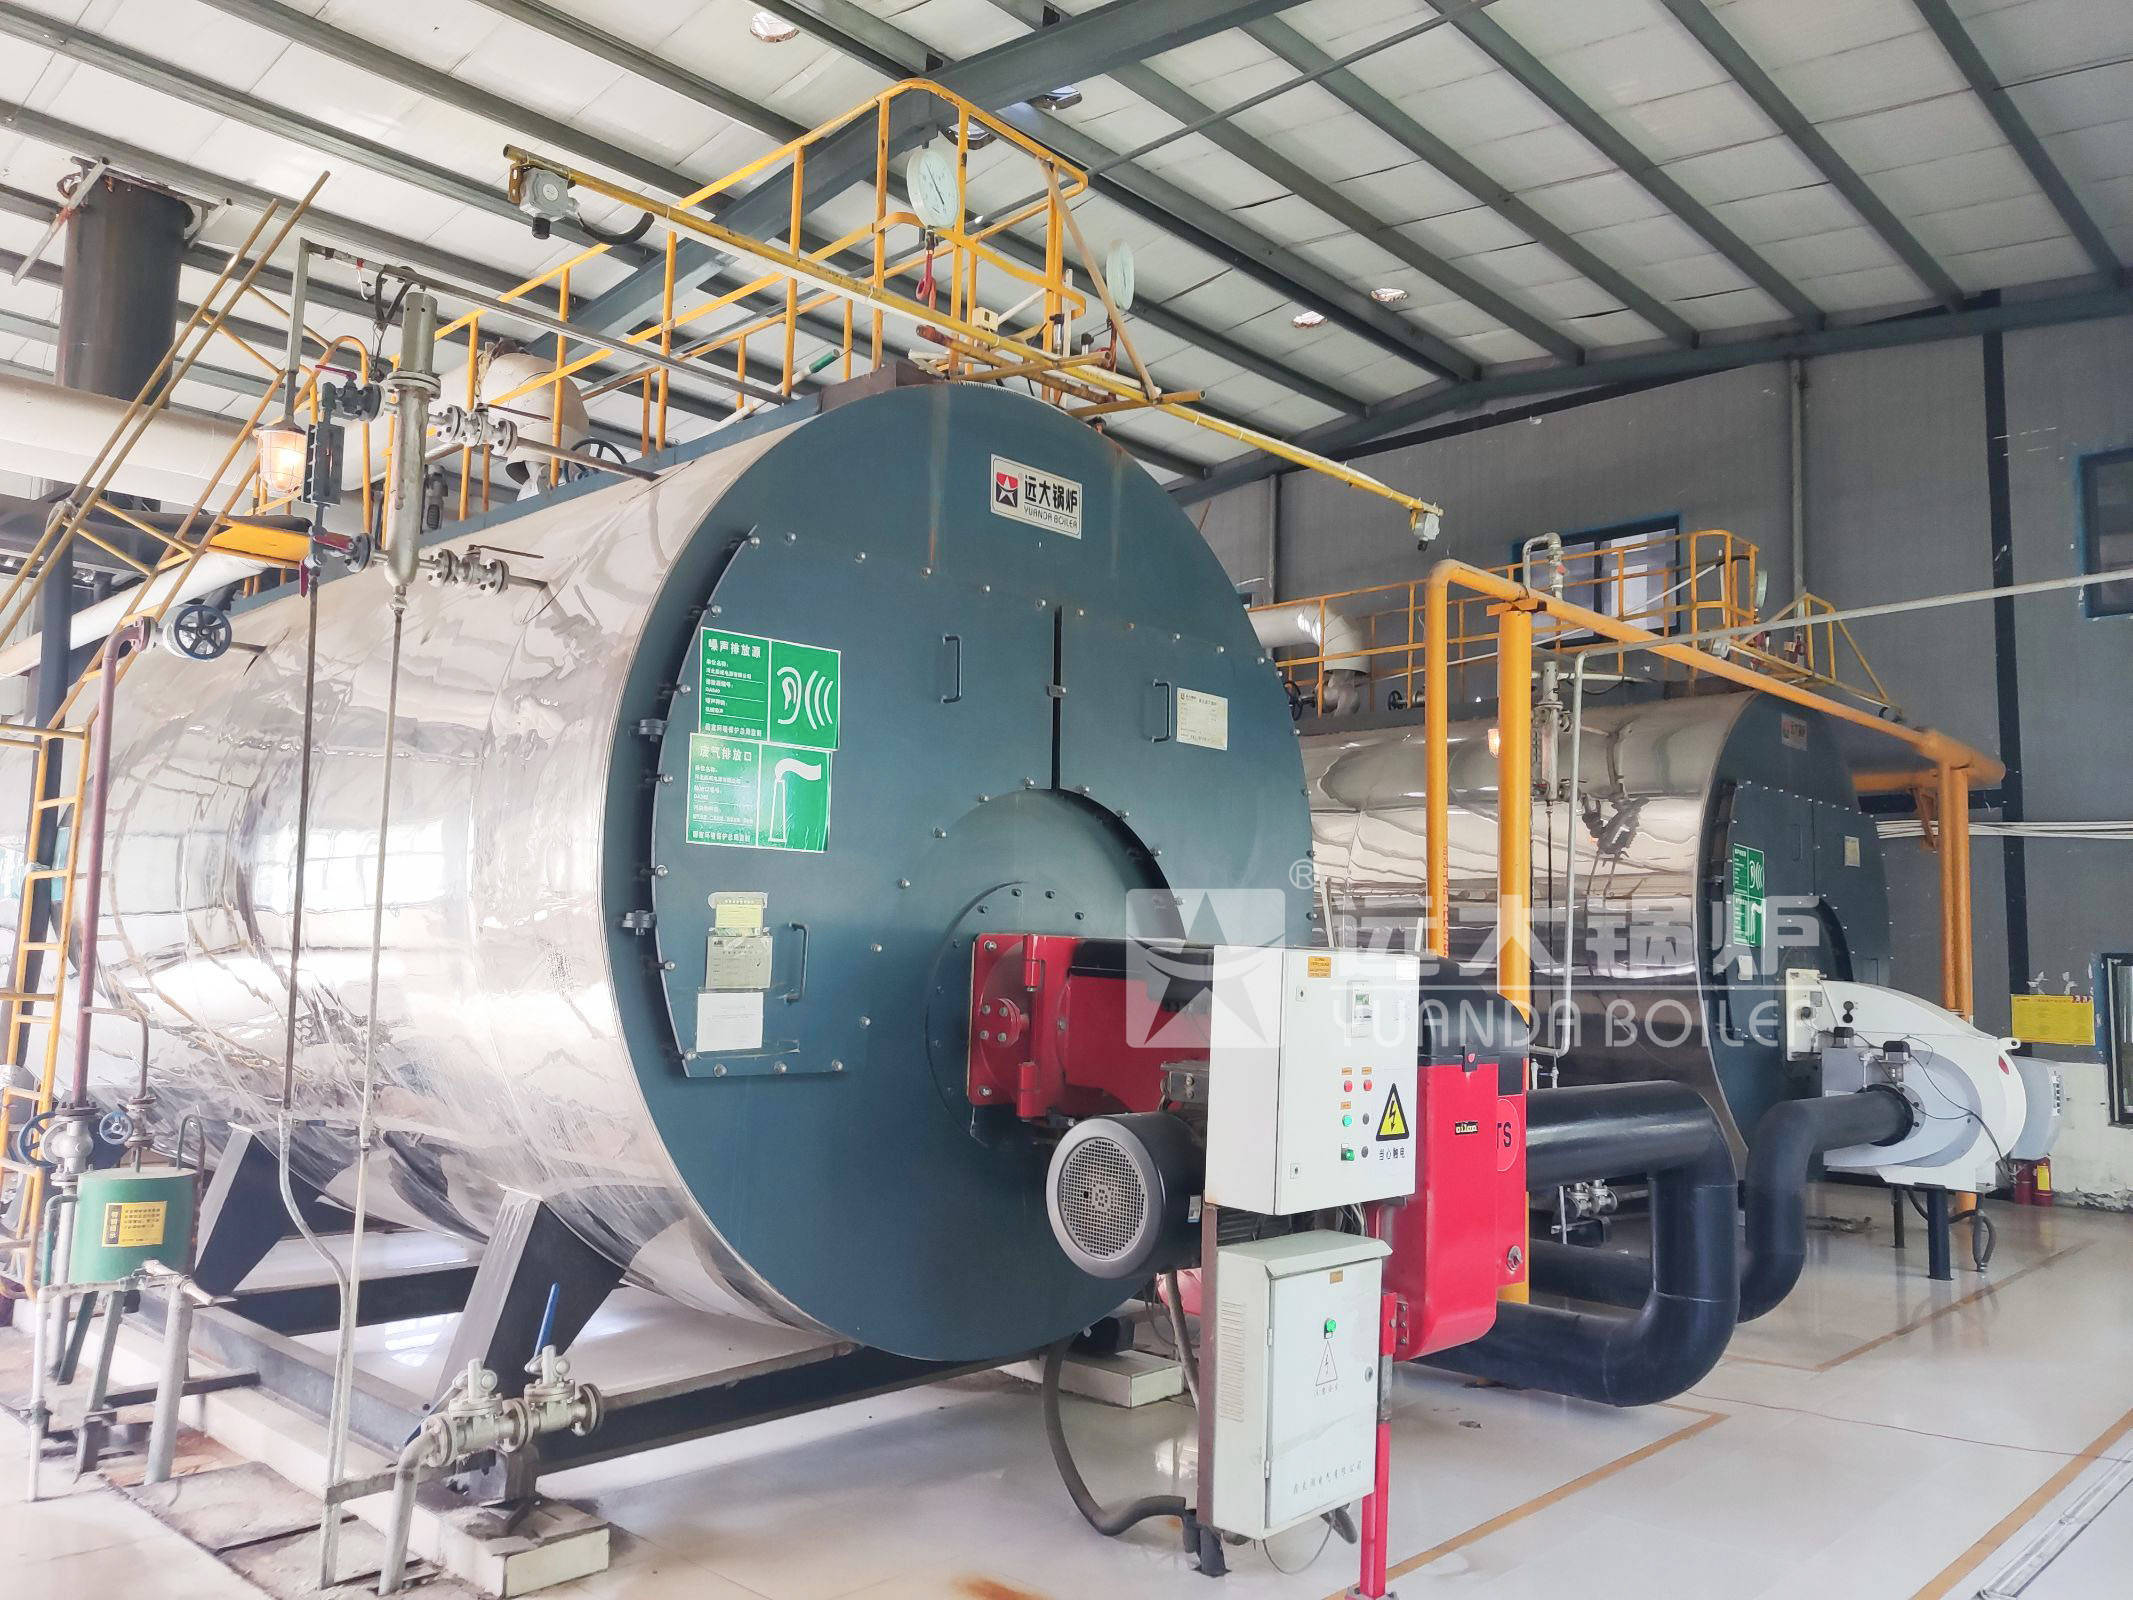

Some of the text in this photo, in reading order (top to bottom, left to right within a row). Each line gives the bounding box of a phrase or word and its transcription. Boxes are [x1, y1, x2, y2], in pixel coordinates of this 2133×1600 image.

[1025, 475, 1077, 513] 远大锅炉
[1024, 505, 1077, 529] YUANDA BOILER
[708, 639, 761, 659] 噪声排放源
[700, 745, 752, 761] 废气排放口
